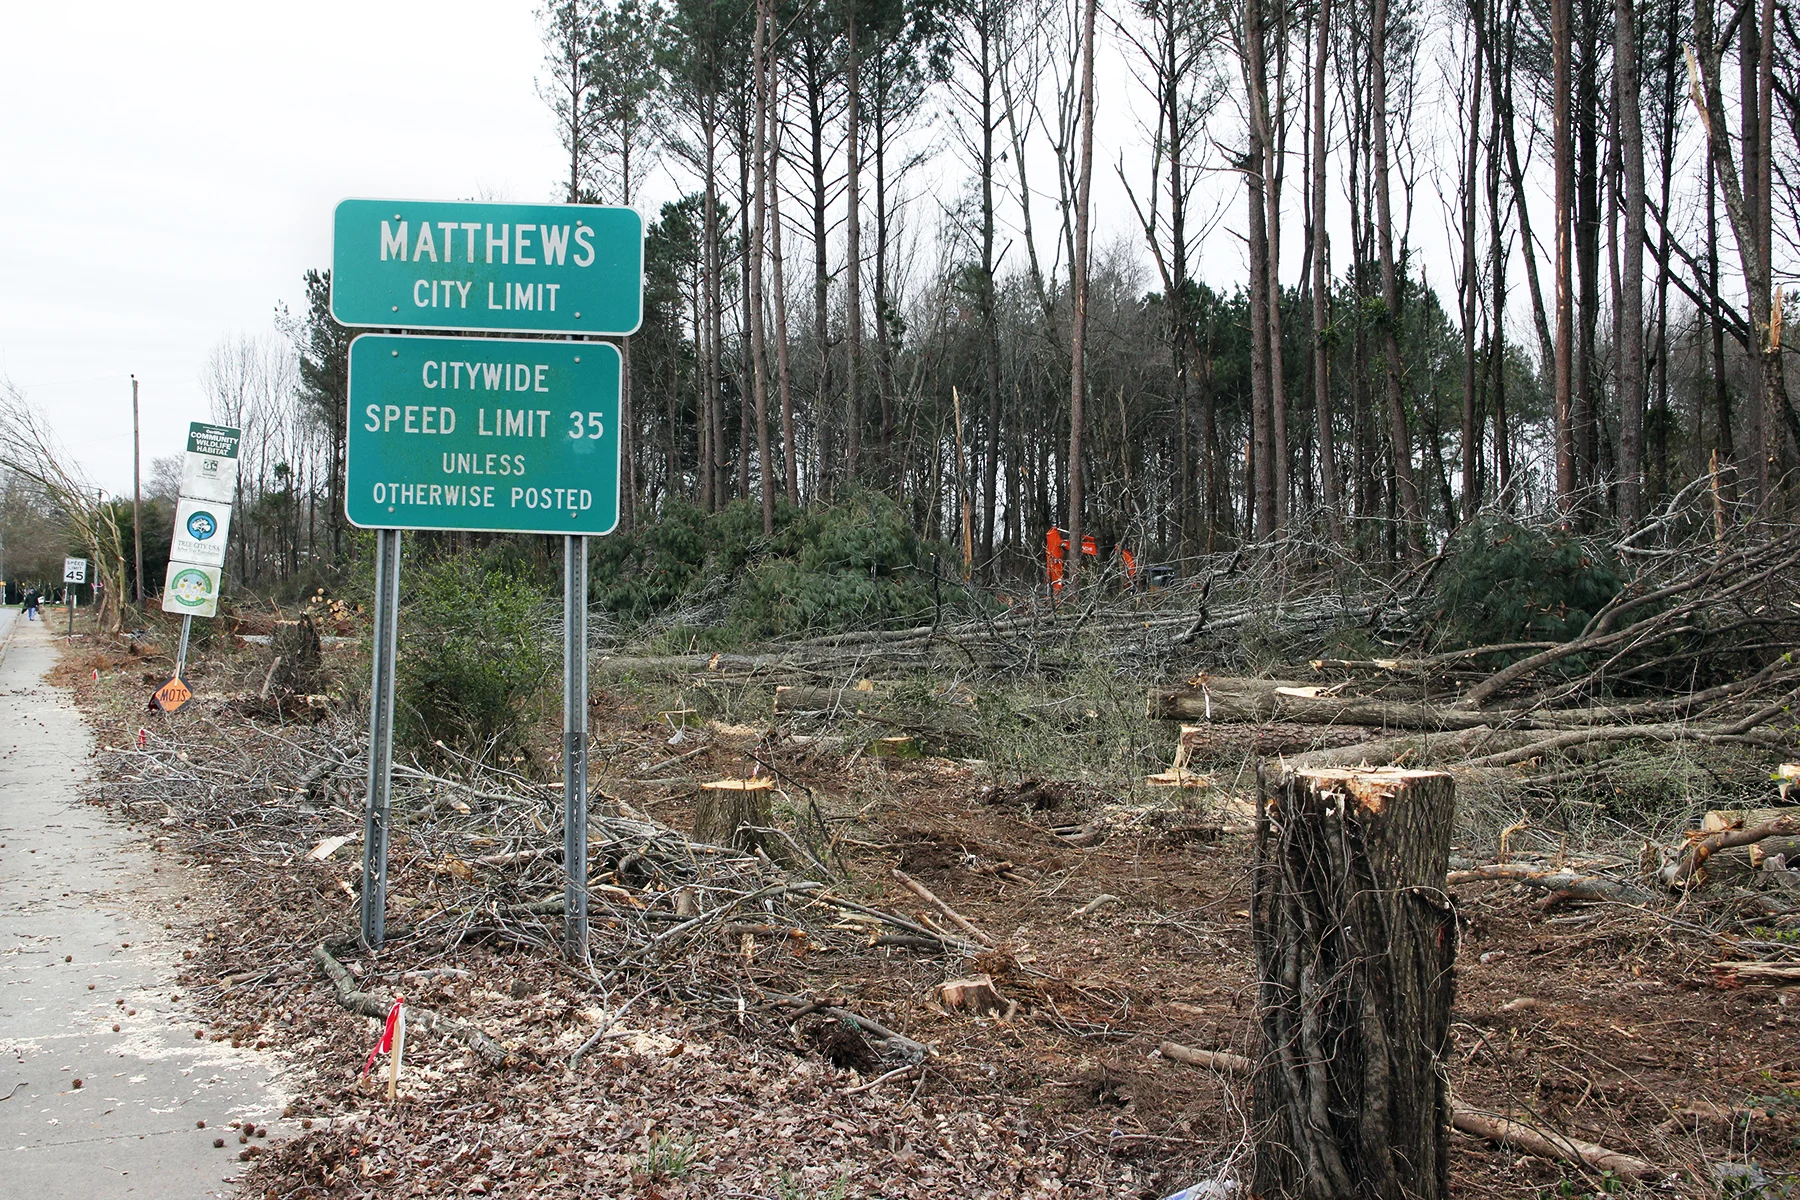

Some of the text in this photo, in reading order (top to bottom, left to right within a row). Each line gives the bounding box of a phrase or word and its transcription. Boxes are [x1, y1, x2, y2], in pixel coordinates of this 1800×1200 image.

[380, 220, 595, 267] MATTHEWS
[413, 279, 561, 312] CITY LIMIT
[422, 360, 549, 392] CITYWIDE
[364, 403, 604, 440] SPEED LIMIT 35
[190, 431, 239, 445] COMMUNITY
[196, 438, 232, 450] WILDLIFE
[196, 445, 229, 456] HABITAT
[443, 453, 525, 476] UNLESS
[373, 482, 592, 510] OTHERWISE POSTED
[178, 540, 193, 548] TREE
[193, 542, 207, 550] CITY
[66, 571, 84, 581] 45
[160, 688, 188, 702] SLOW
